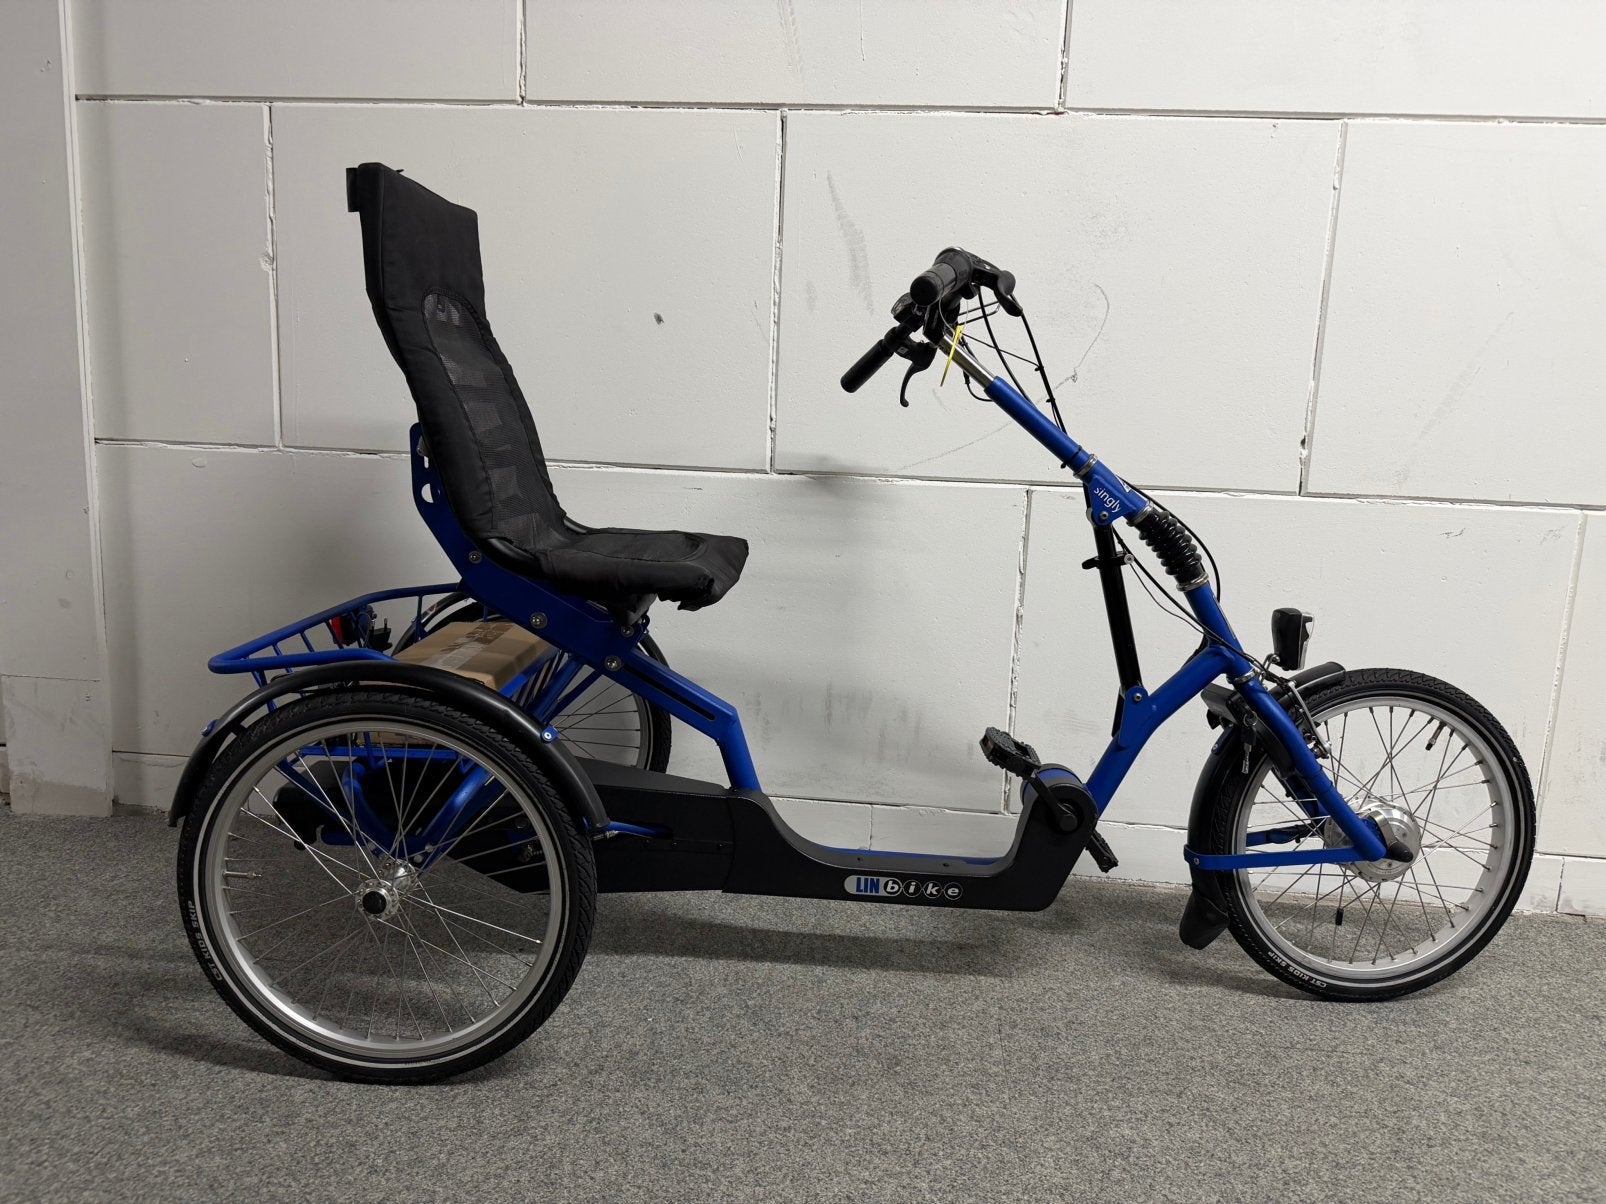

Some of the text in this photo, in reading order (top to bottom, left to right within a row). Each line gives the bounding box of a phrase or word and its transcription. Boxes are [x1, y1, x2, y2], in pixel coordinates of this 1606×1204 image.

[1093, 487, 1121, 513] singly
[187, 900, 222, 981] CST KIDS SKIP
[1267, 951, 1327, 988] CST KIDS SKIP
